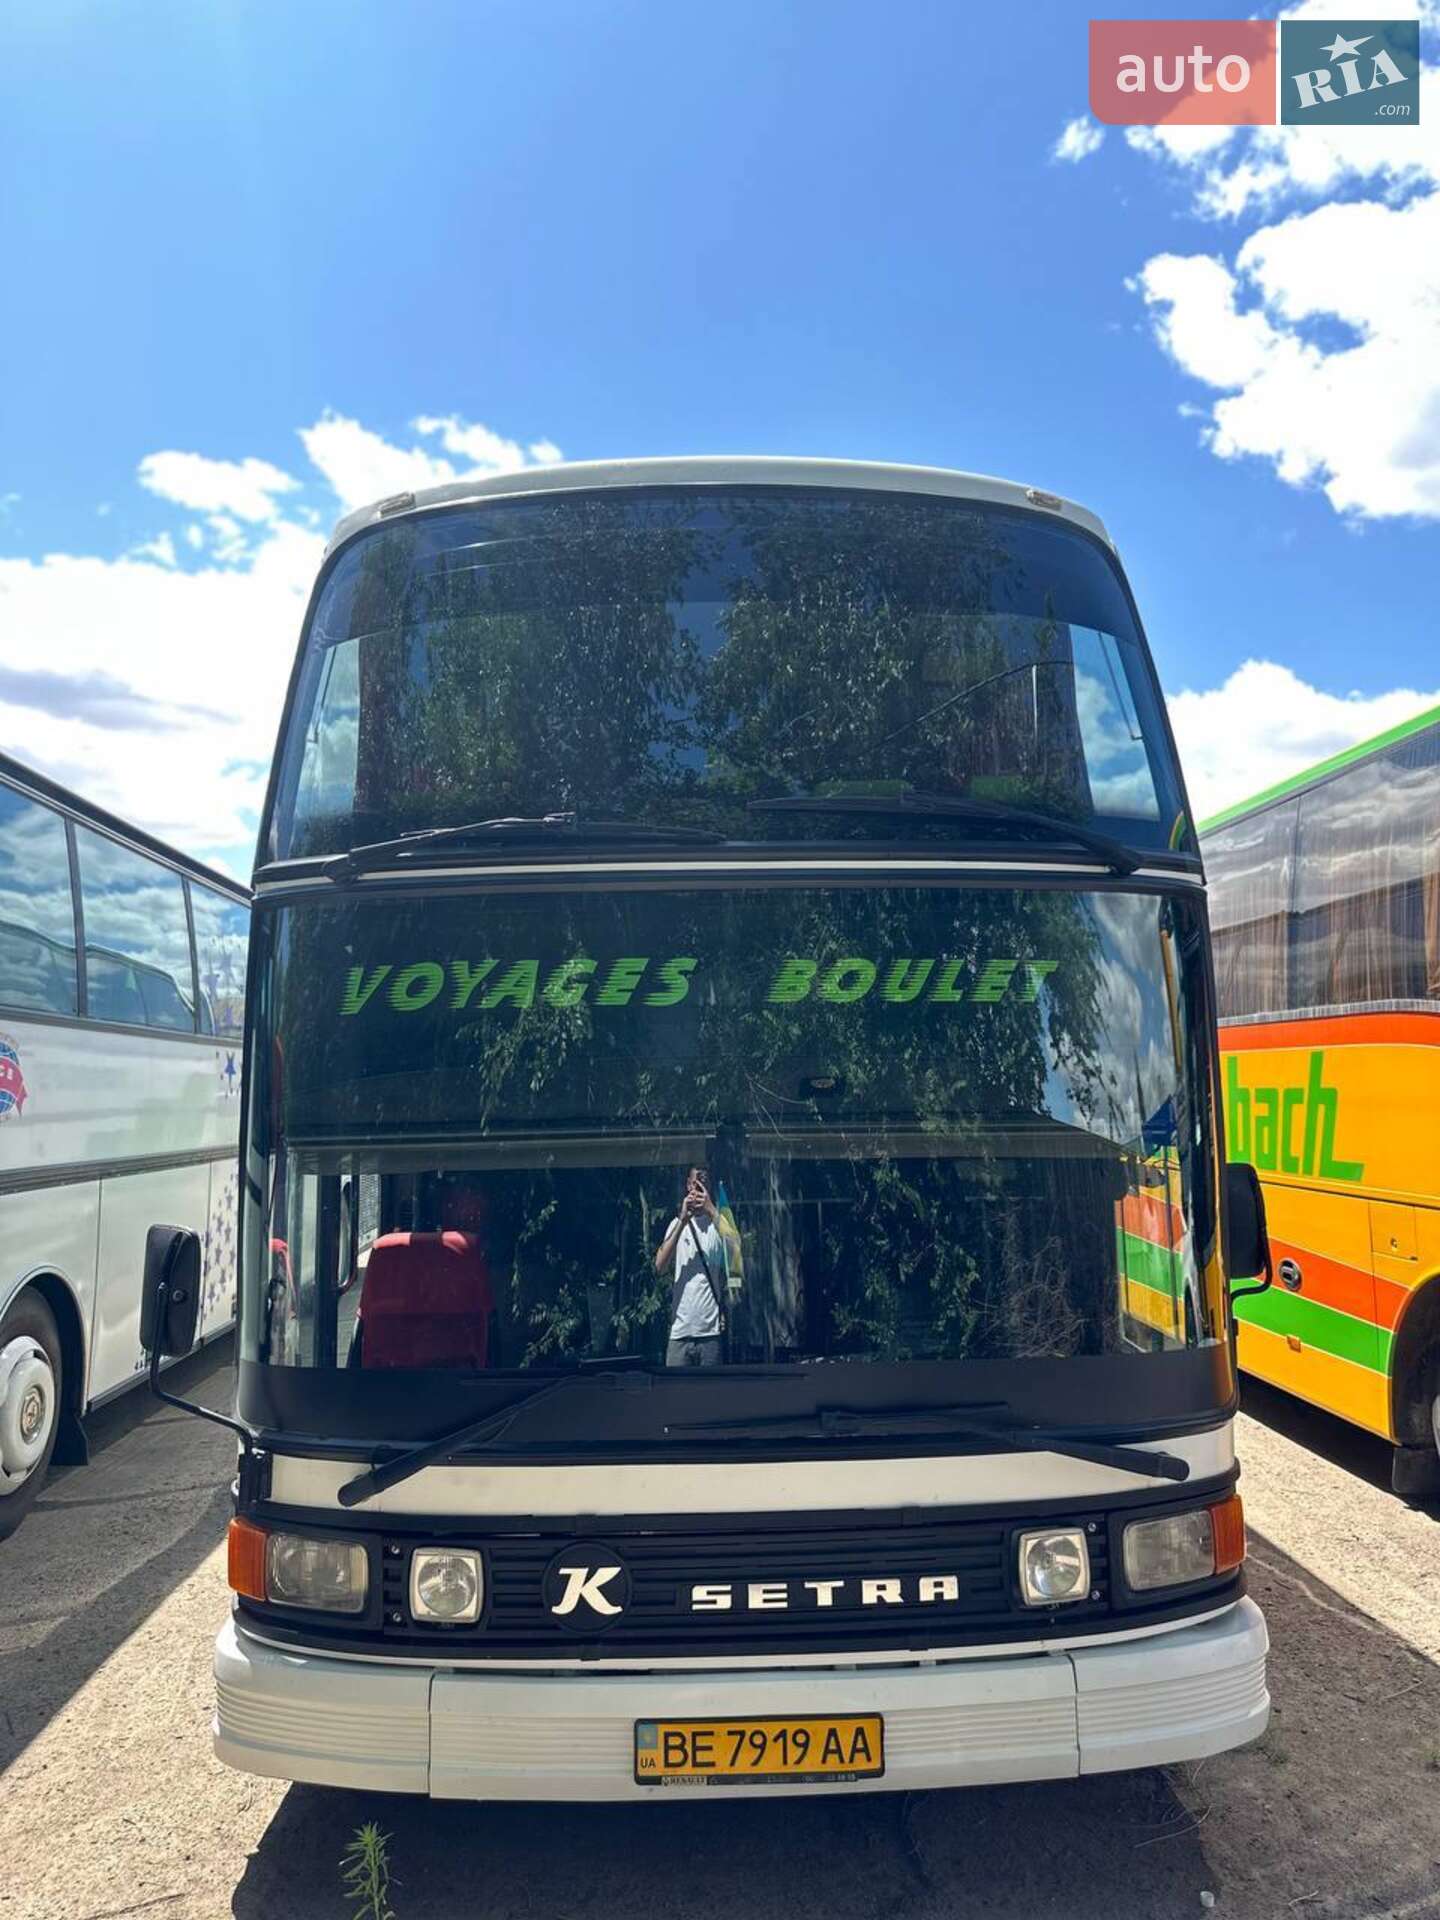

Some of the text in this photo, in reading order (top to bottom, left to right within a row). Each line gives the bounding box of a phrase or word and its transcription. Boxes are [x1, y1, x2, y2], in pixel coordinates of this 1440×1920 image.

[339, 957, 1061, 1016] VOYAGES BOULET
[1227, 1050, 1365, 1182] bach
[691, 1575, 960, 1611] SETRA
[640, 1757, 656, 1769] UA
[663, 1726, 873, 1768] BE 7919 AA
